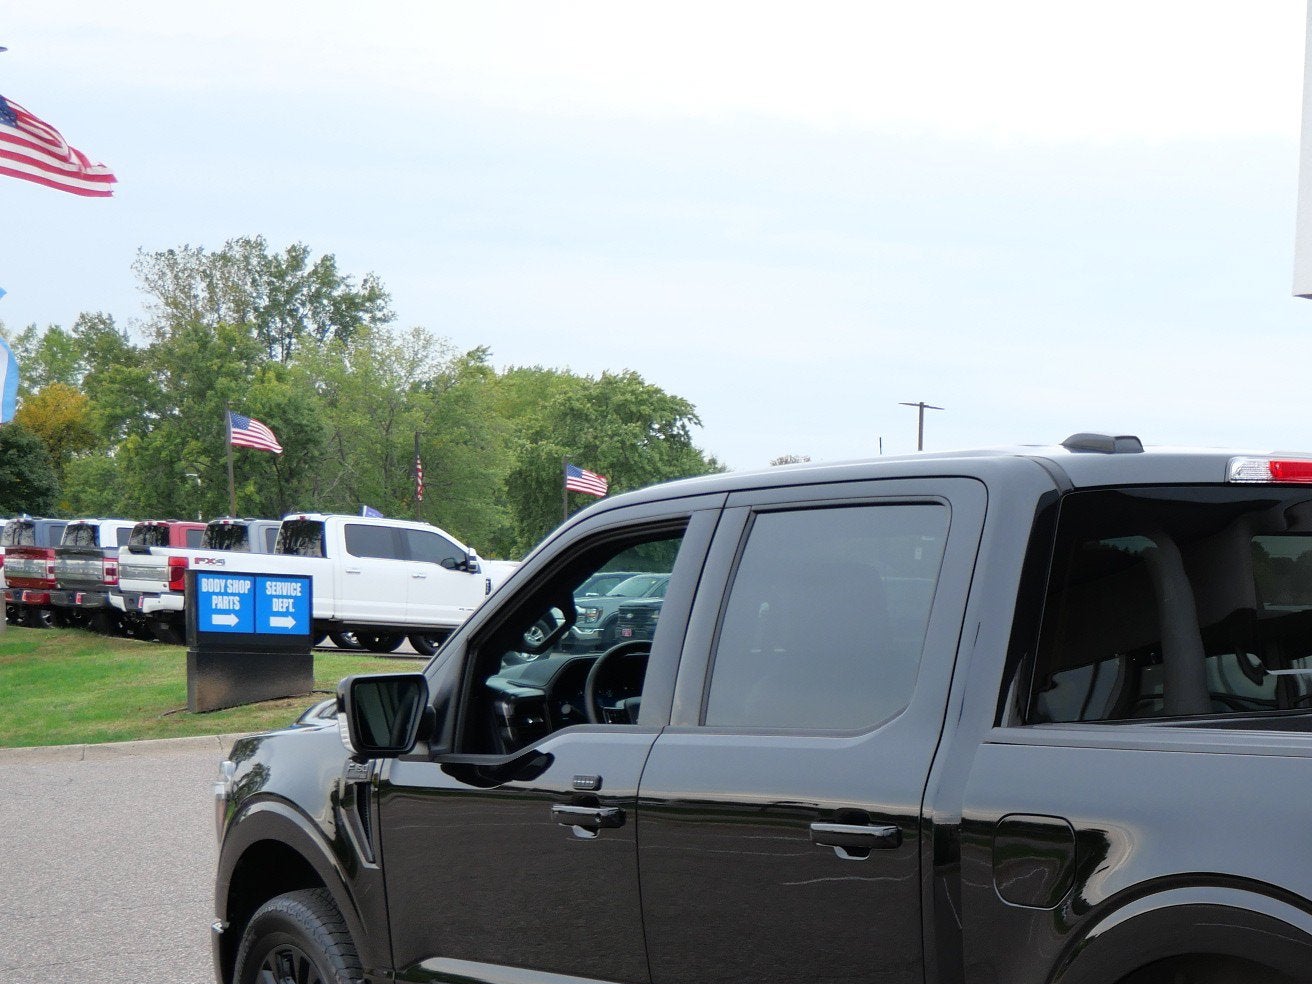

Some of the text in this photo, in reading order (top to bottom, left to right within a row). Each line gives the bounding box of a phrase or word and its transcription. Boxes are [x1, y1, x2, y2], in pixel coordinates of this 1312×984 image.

[201, 578, 251, 594] BODY SHOP
[265, 581, 302, 597] SERVICE
[211, 595, 241, 610] PARTS
[272, 598, 295, 613] DEPT.
